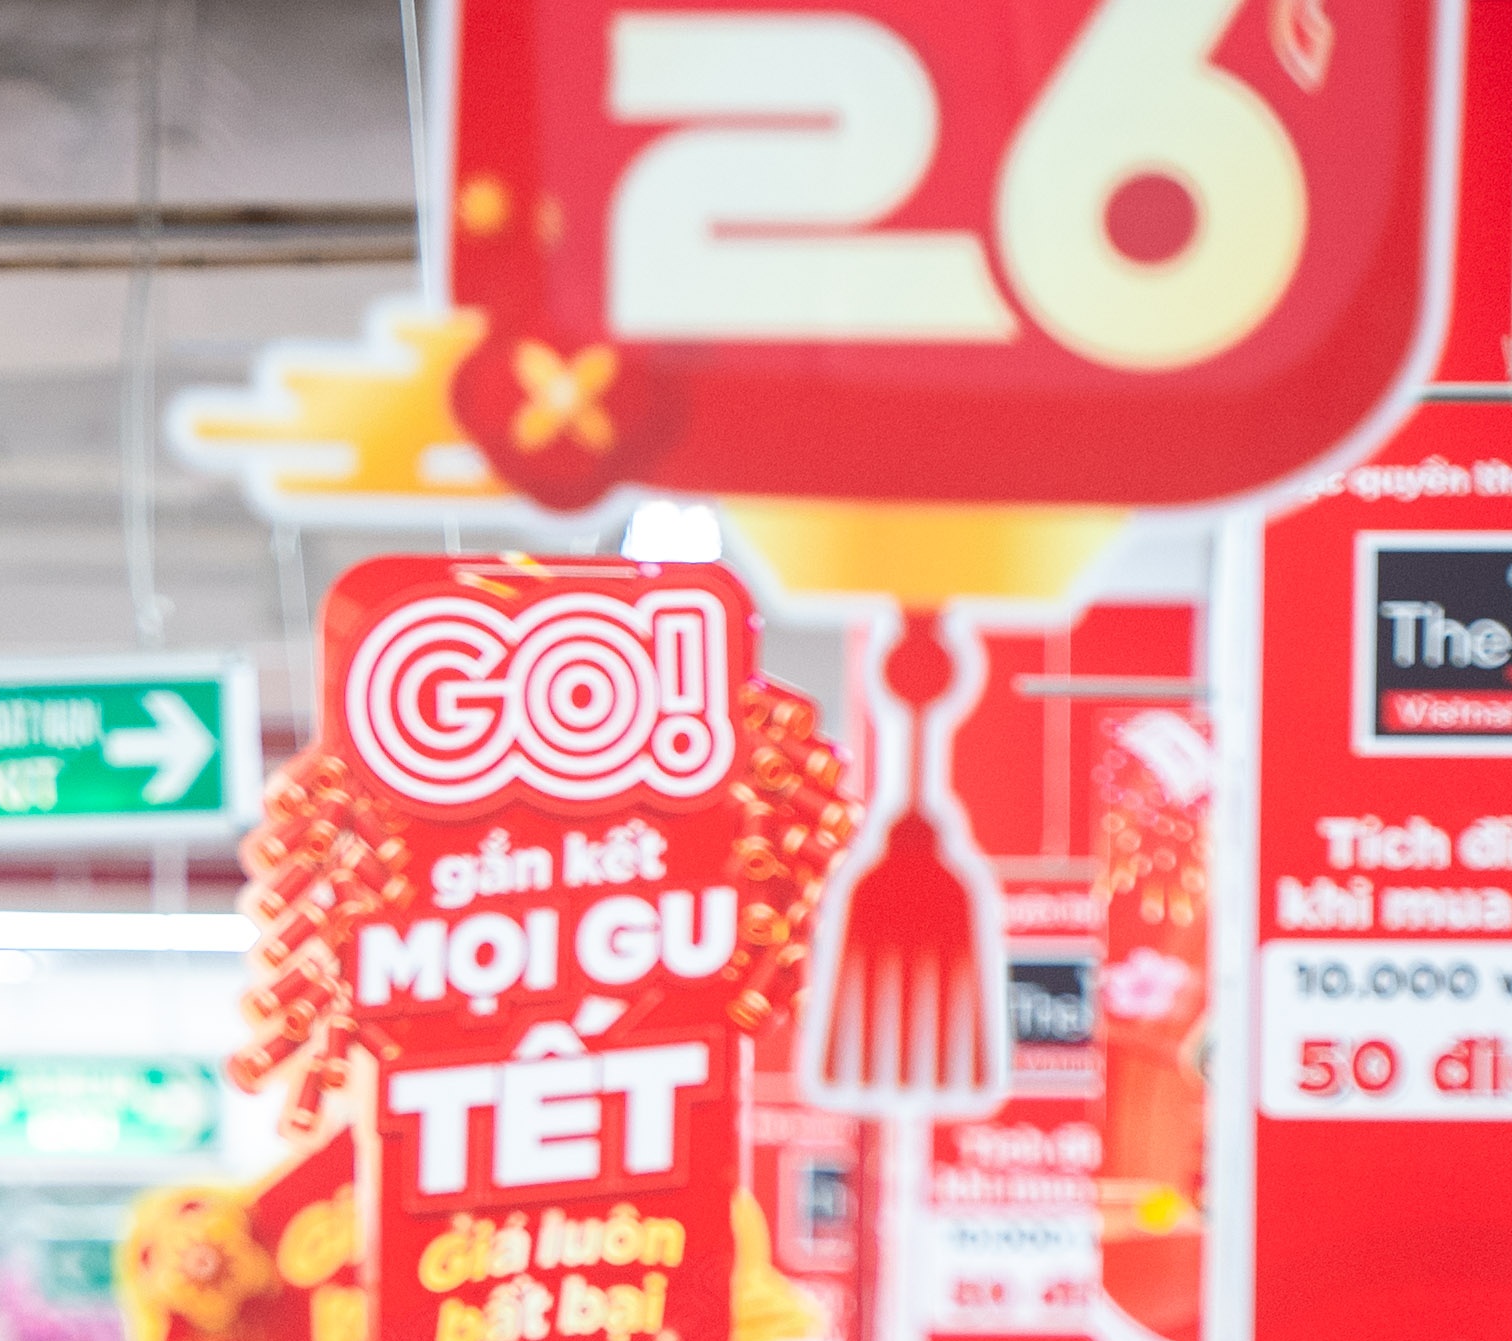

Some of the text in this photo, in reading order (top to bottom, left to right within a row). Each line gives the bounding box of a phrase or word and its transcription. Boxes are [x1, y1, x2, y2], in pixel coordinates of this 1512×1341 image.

[606, 0, 1309, 372] 26
[345, 588, 737, 803] GO!
[432, 817, 667, 908] gắn kết
[1317, 814, 1453, 870] Tích
[1277, 874, 1375, 932] khi
[358, 886, 738, 1017] MỌI GU
[1295, 959, 1481, 1000] 10.000
[389, 996, 710, 1196] TẾT
[1297, 1038, 1398, 1098] 50
[418, 1211, 530, 1293] Giá
[537, 1201, 687, 1267] luôn
